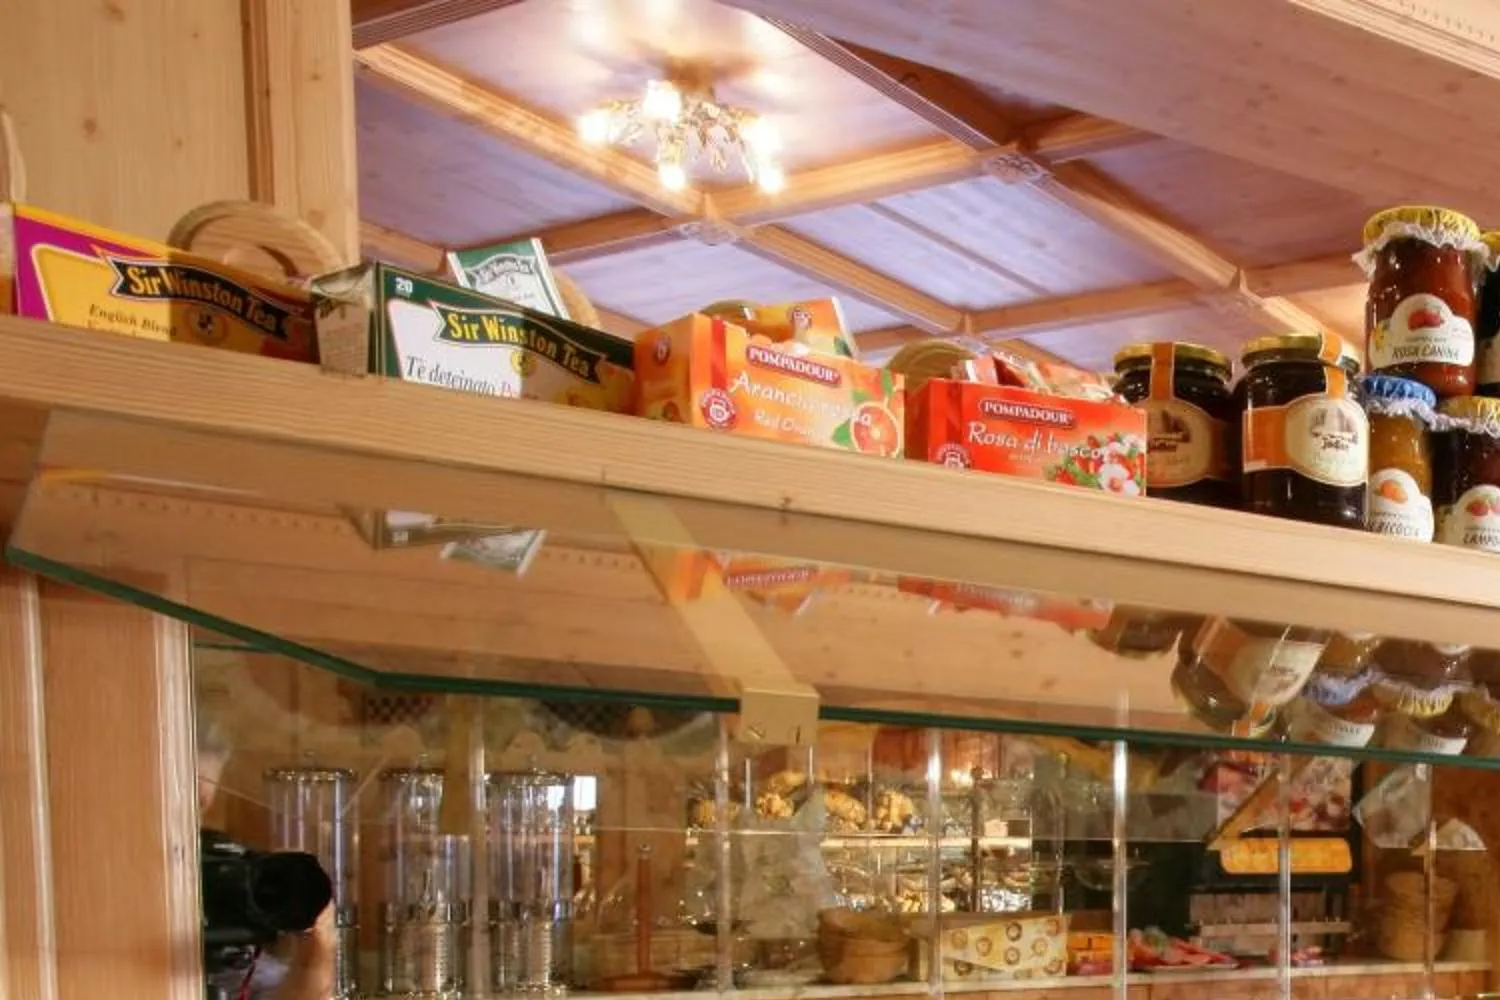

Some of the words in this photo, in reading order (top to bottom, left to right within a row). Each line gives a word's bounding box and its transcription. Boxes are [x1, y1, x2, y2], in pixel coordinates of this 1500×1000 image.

[126, 265, 161, 295] Sir
[161, 267, 243, 314] Winston
[245, 296, 278, 330] Tea
[395, 277, 414, 293] 20
[447, 313, 480, 341] Sir
[483, 316, 557, 357] Winston
[561, 341, 590, 376] Tea
[749, 348, 836, 382] POMPADOUR
[984, 400, 1070, 425] POMPADOUR
[968, 420, 1018, 449] Rosa
